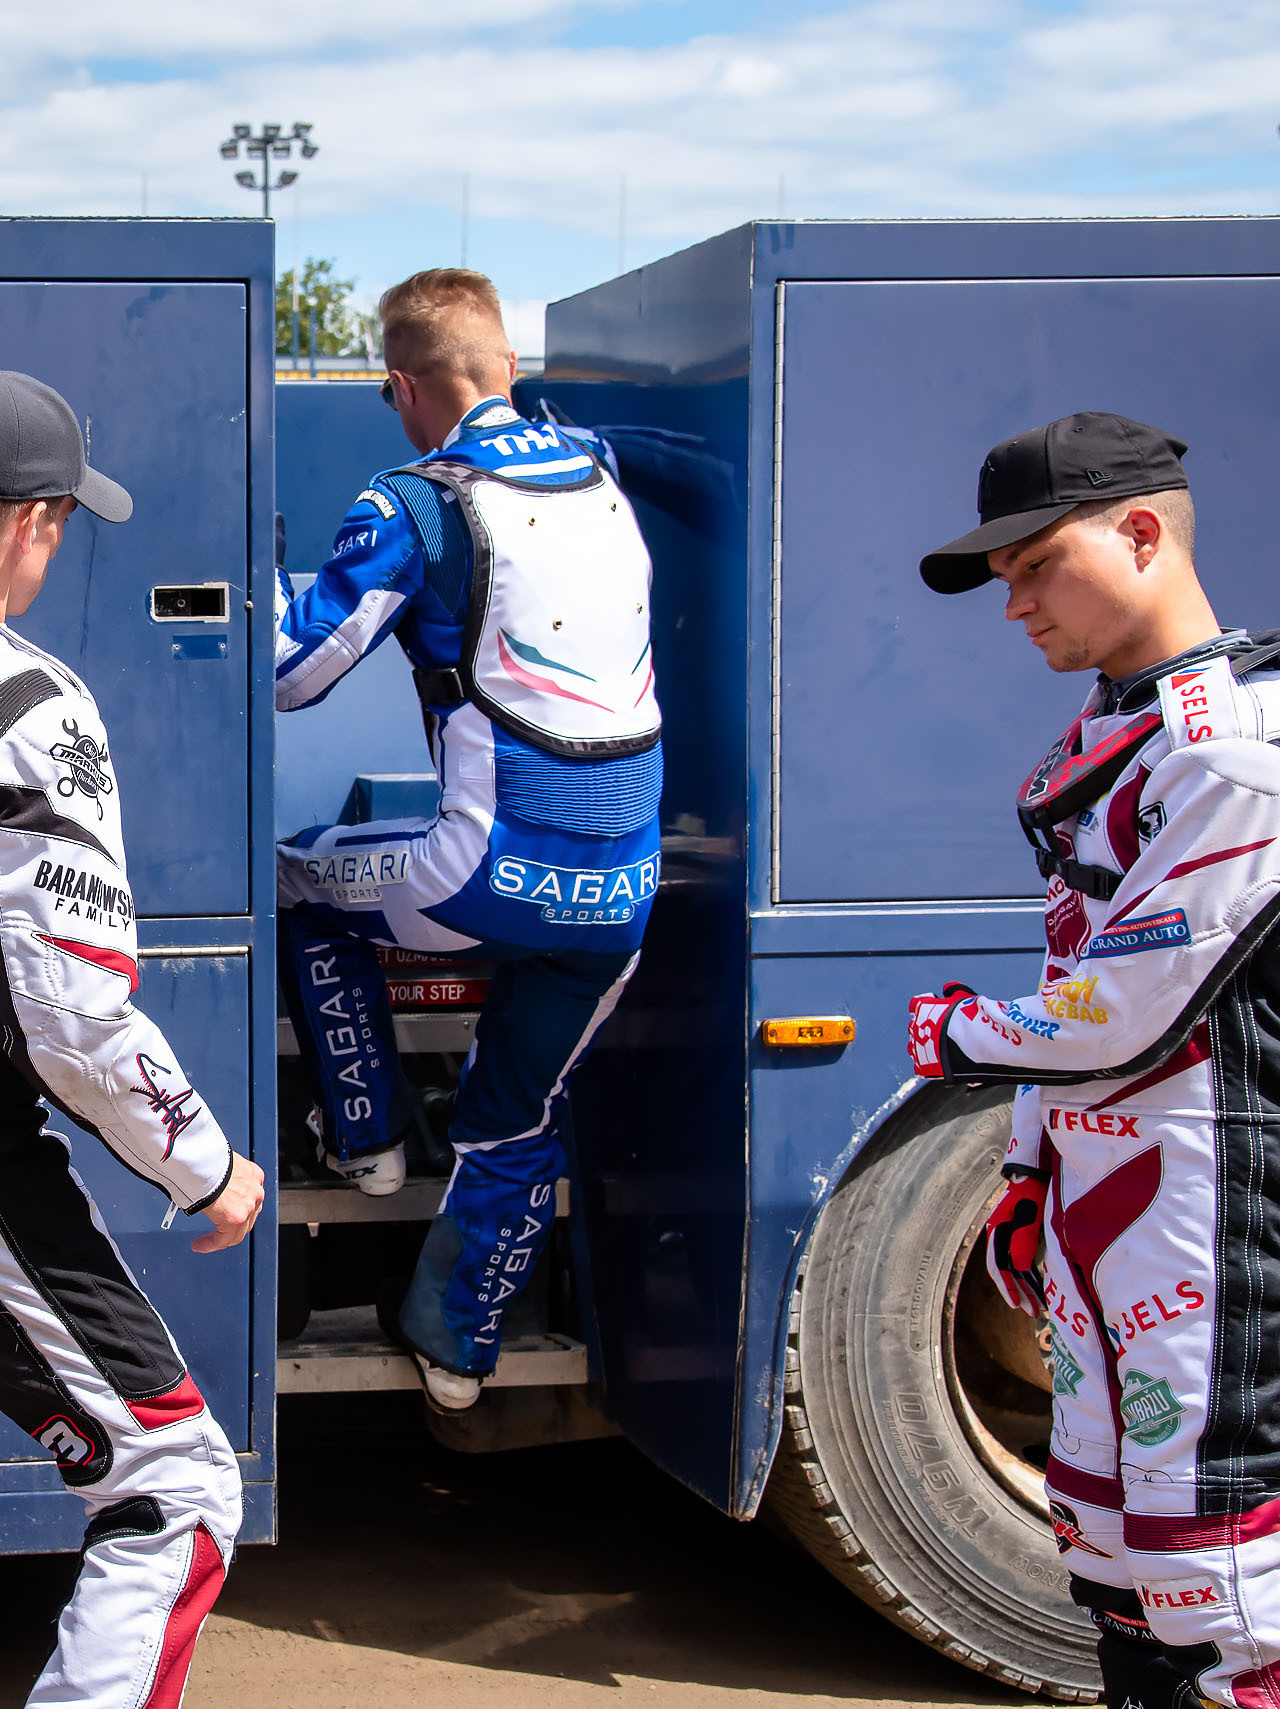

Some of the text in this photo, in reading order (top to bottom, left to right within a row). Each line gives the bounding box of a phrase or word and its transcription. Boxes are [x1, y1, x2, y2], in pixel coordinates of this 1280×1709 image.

[1180, 685, 1213, 743] SELS
[305, 853, 409, 886] SAGARI
[494, 855, 660, 904] SAGARI
[335, 888, 381, 900] SPORTS
[55, 898, 130, 932] FAMILY
[545, 906, 632, 921] SPORTS
[1091, 924, 1187, 950] GRAND AUTO
[389, 984, 466, 1001] YOUR STEP
[1046, 997, 1109, 1024] KEBAB
[304, 944, 373, 1123] SAGARI
[352, 986, 380, 1069] SPORTS
[474, 1183, 552, 1345] SAGARI
[477, 1227, 512, 1303] SPORTS
[1121, 1280, 1205, 1340] SELS
[1007, 1553, 1072, 1594] SNOW
[1092, 1613, 1138, 1637] GRAND
